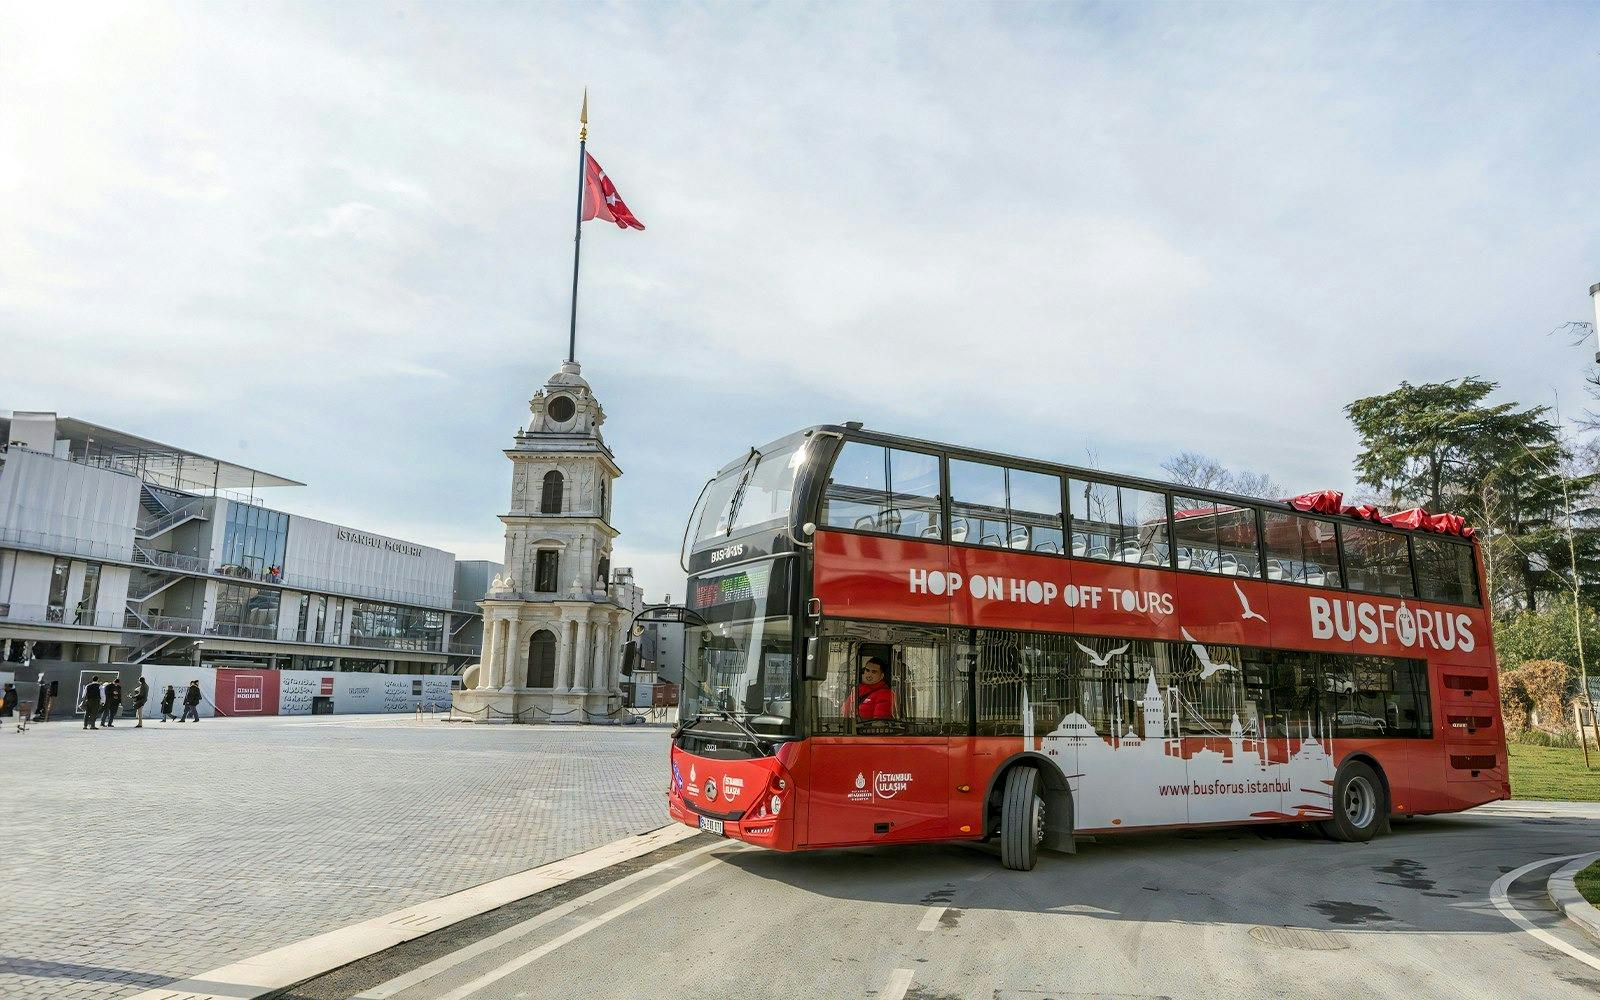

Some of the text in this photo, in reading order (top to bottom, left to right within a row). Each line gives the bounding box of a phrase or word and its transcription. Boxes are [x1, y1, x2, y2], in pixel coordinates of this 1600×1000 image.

[909, 568, 1174, 615] HOP ON HOP OFF TOURS
[1309, 596, 1475, 653] BUSFORUS
[1158, 778, 1292, 796] www.busforus.istanbul
